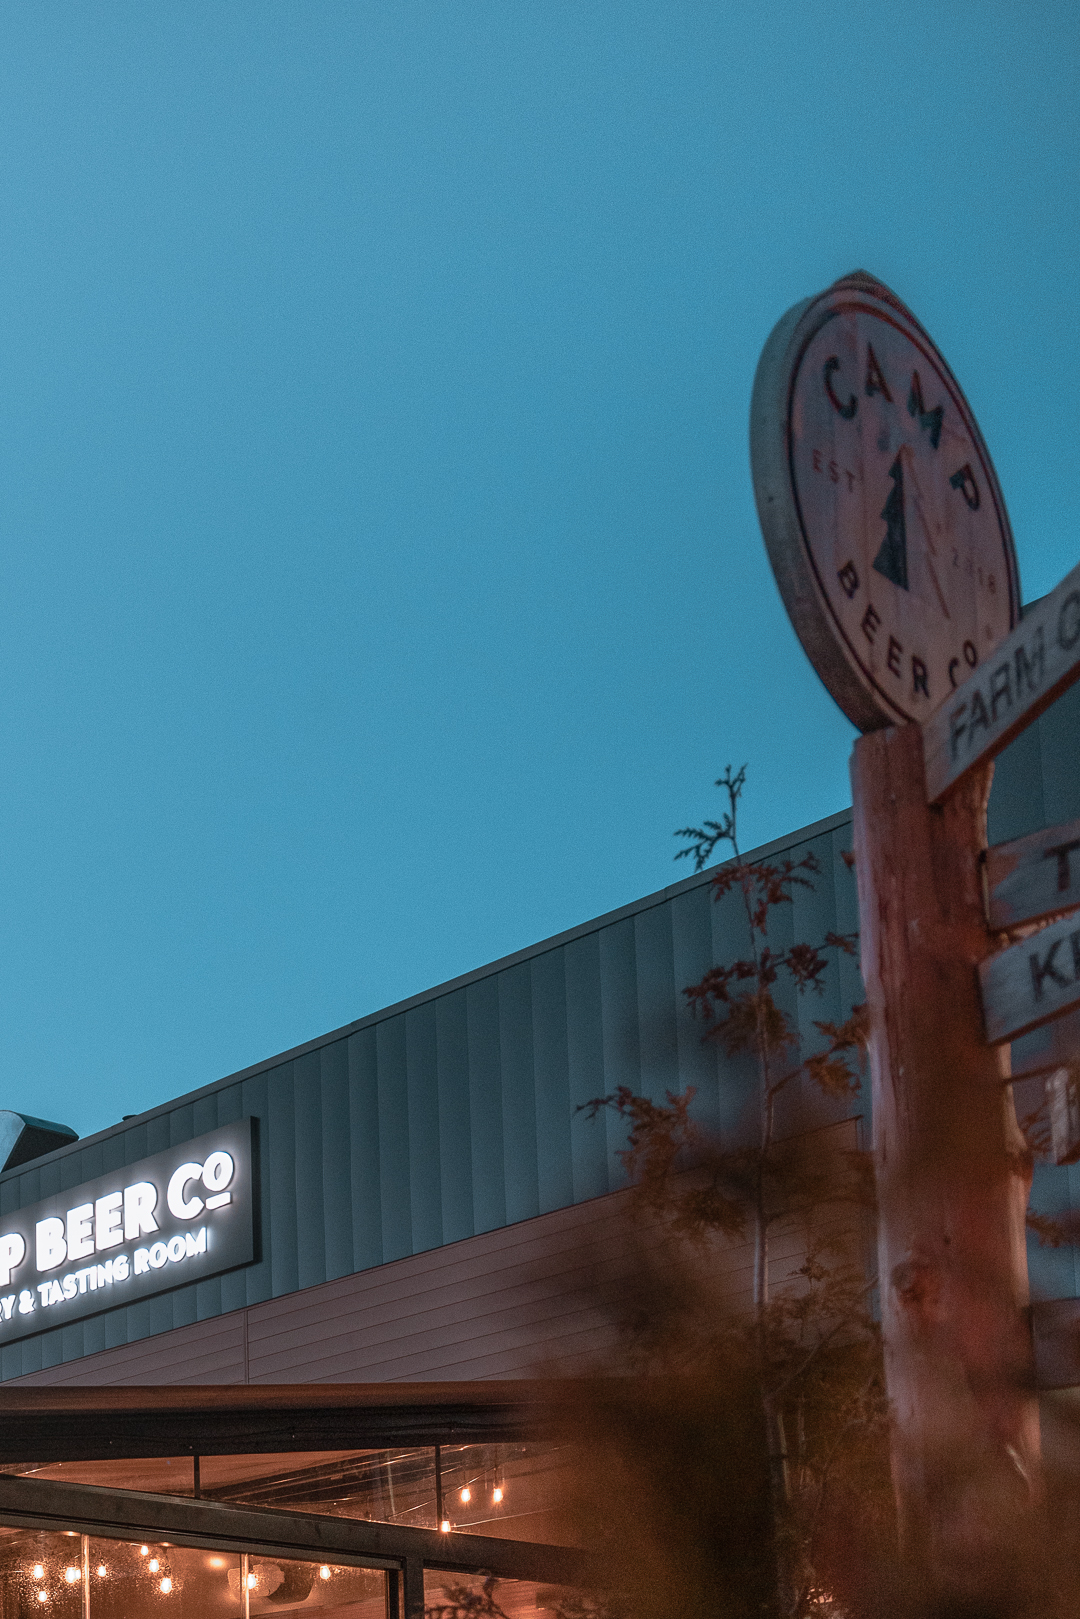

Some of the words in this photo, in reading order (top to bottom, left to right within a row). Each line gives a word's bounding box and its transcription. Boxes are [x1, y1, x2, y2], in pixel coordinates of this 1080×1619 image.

[812, 449, 855, 493] EST
[823, 342, 980, 511] CAMP
[837, 559, 929, 698] BEER
[949, 625, 1045, 764] FARM
[18, 1289, 35, 1314] &
[37, 1255, 130, 1307] TASTING
[134, 1226, 208, 1275] ROOM
[36, 1182, 160, 1272] BEER
